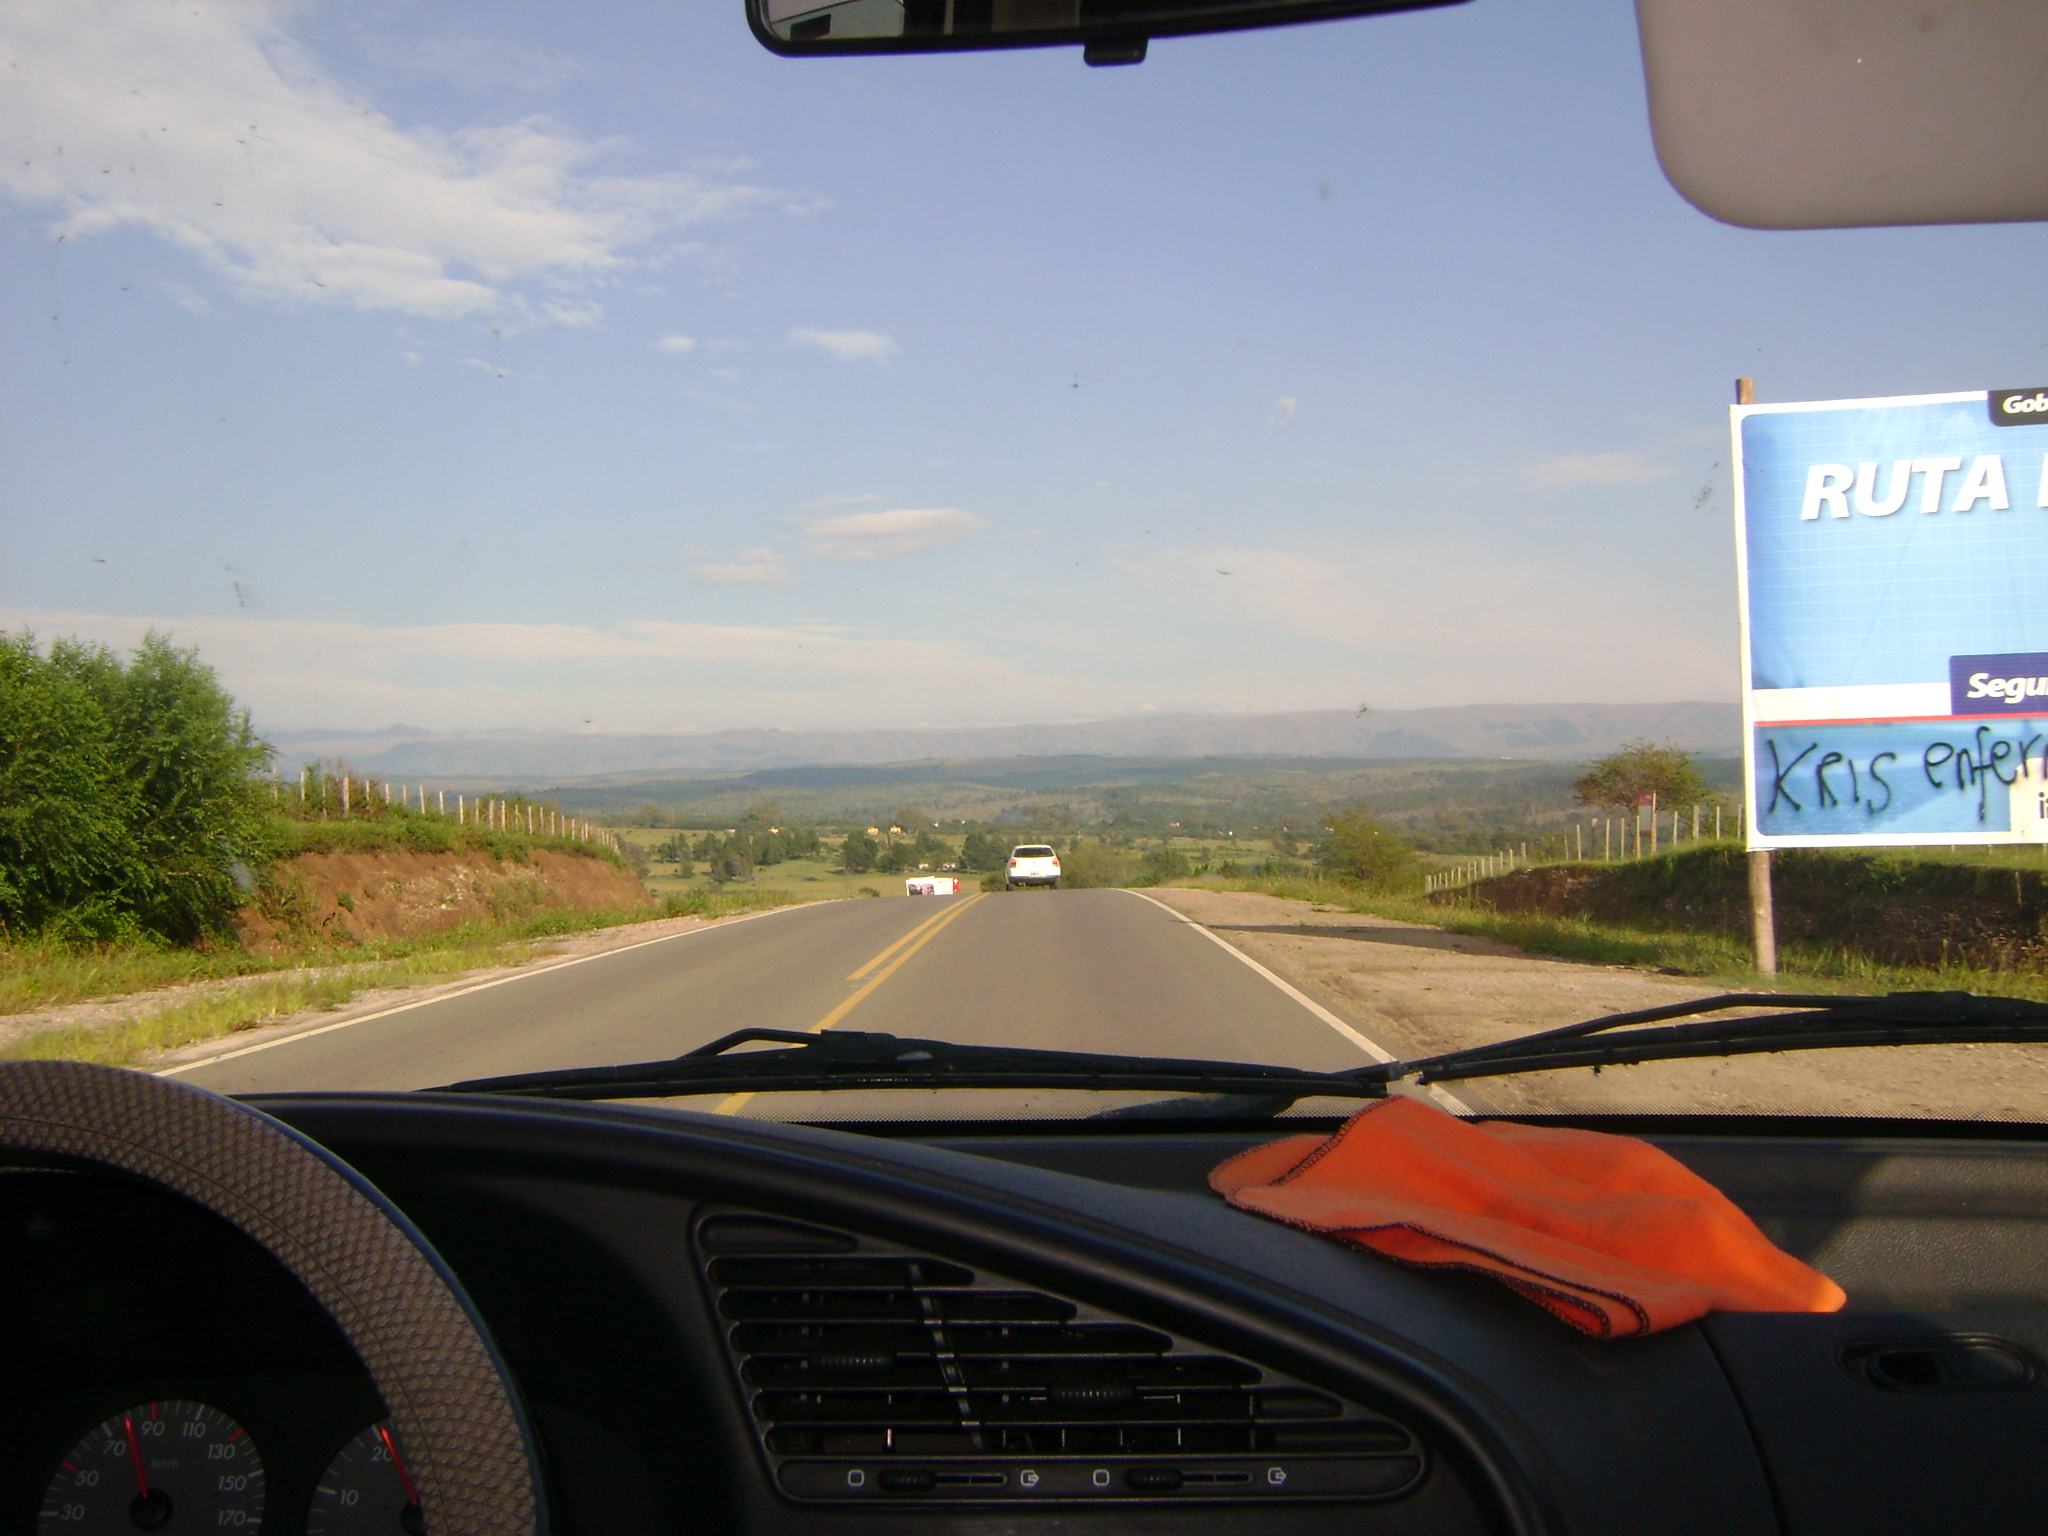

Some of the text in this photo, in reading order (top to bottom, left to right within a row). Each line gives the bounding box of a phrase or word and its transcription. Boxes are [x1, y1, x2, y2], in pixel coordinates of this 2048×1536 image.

[1801, 454, 2010, 521] RUTA
[1967, 672, 2048, 704] Segu
[1924, 726, 2048, 824] enfer
[142, 1421, 165, 1436] 90
[183, 1422, 206, 1437] 110
[103, 1440, 126, 1456] 70
[208, 1444, 235, 1459] 130
[75, 1470, 99, 1486] 50
[219, 1475, 247, 1491] 150
[341, 1489, 358, 1506] 10
[61, 1504, 84, 1520] 30
[219, 1510, 246, 1526] 170
